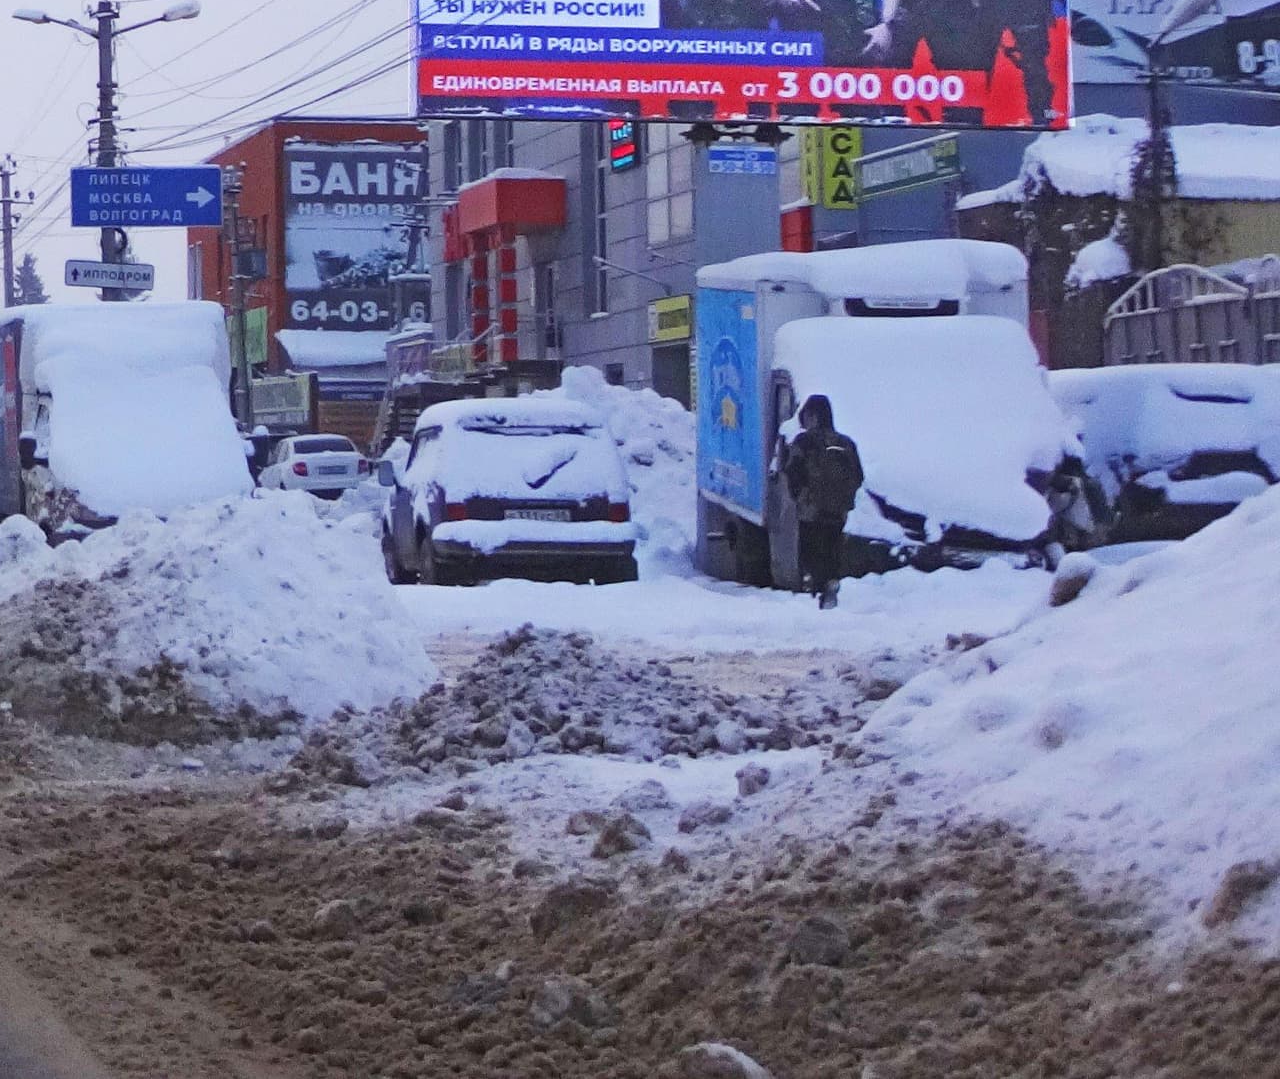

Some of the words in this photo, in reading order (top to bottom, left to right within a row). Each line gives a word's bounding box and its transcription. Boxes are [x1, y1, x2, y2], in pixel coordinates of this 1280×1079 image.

[434, 0, 464, 13] ТЫ
[472, 0, 546, 15] НУЖЕН
[554, 2, 645, 16] РОССИИ!
[433, 33, 524, 50] ВСТУПАЙ
[529, 37, 541, 50] В
[547, 37, 604, 54] РЯДЫ
[610, 38, 766, 55] ВООРУЖЕННЫХ
[771, 41, 813, 56] СИЛ
[433, 76, 621, 93] ЕДИНОВРЕМЕННАЯ
[627, 79, 725, 95] ВЫПЛАТА
[777, 72, 800, 98] 3
[809, 72, 882, 99] 000
[892, 74, 964, 102] 000
[89, 173, 151, 186] ЛИПЕЦК
[290, 161, 420, 195] БАНЯ
[89, 193, 153, 204] МОСКВА
[298, 202, 324, 215] на
[89, 210, 183, 223] ВОЛГОГРАД
[83, 269, 151, 282] ИППОДРОМ
[291, 300, 425, 322] 64-03-6
